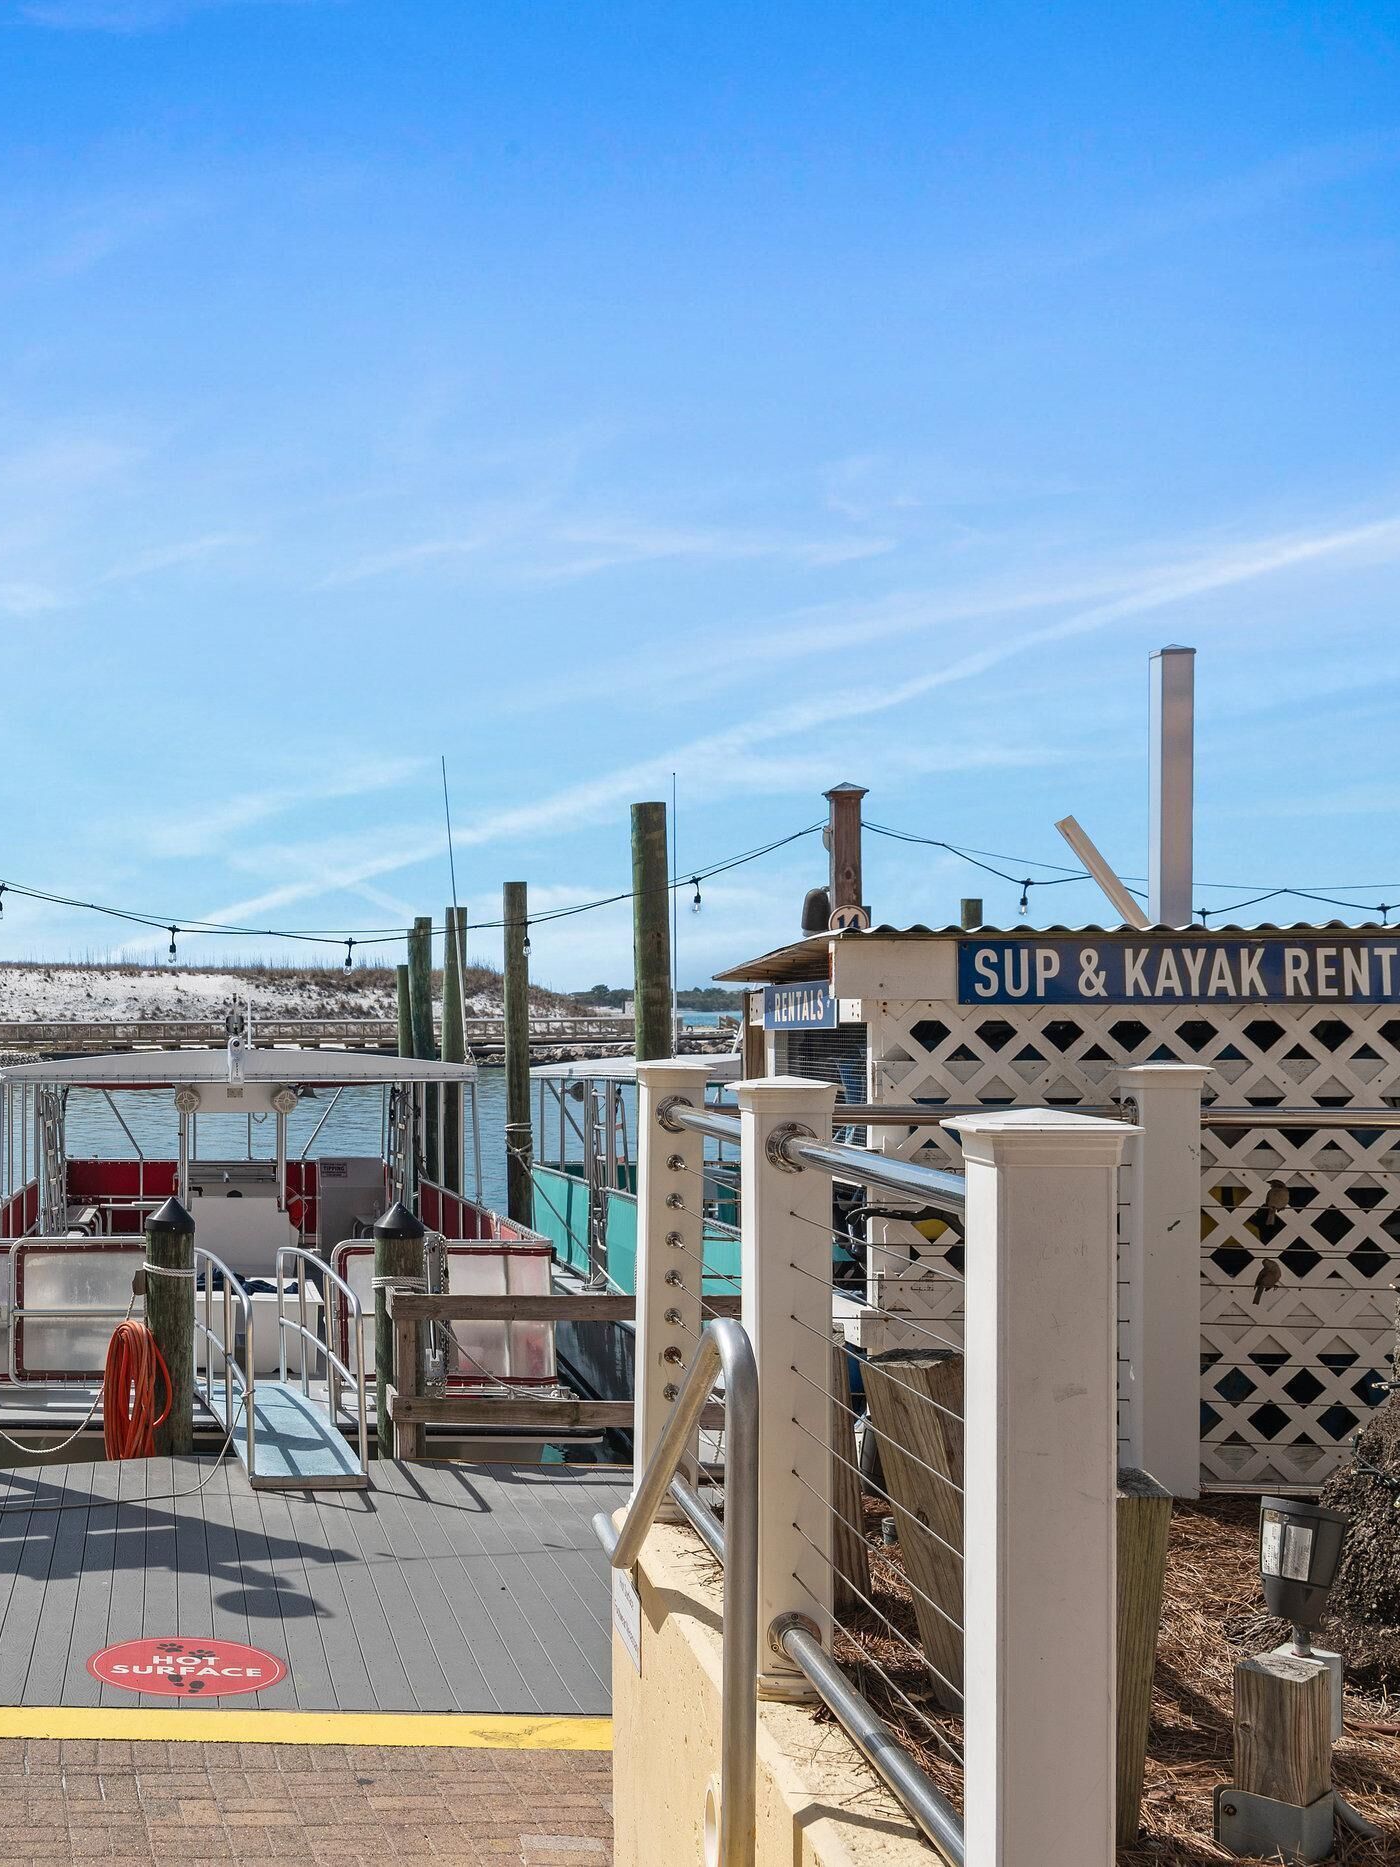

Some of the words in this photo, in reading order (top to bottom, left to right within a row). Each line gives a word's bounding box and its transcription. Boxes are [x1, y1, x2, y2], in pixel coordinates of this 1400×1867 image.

[837, 914, 861, 928] 14
[974, 948, 1060, 997] SUP
[1078, 948, 1107, 997] &
[1125, 947, 1269, 997] KAYAK
[1284, 947, 1400, 997] RENT
[774, 988, 824, 1022] RENTALS
[152, 1655, 221, 1666] HOT
[110, 1664, 262, 1677] SURFACE
